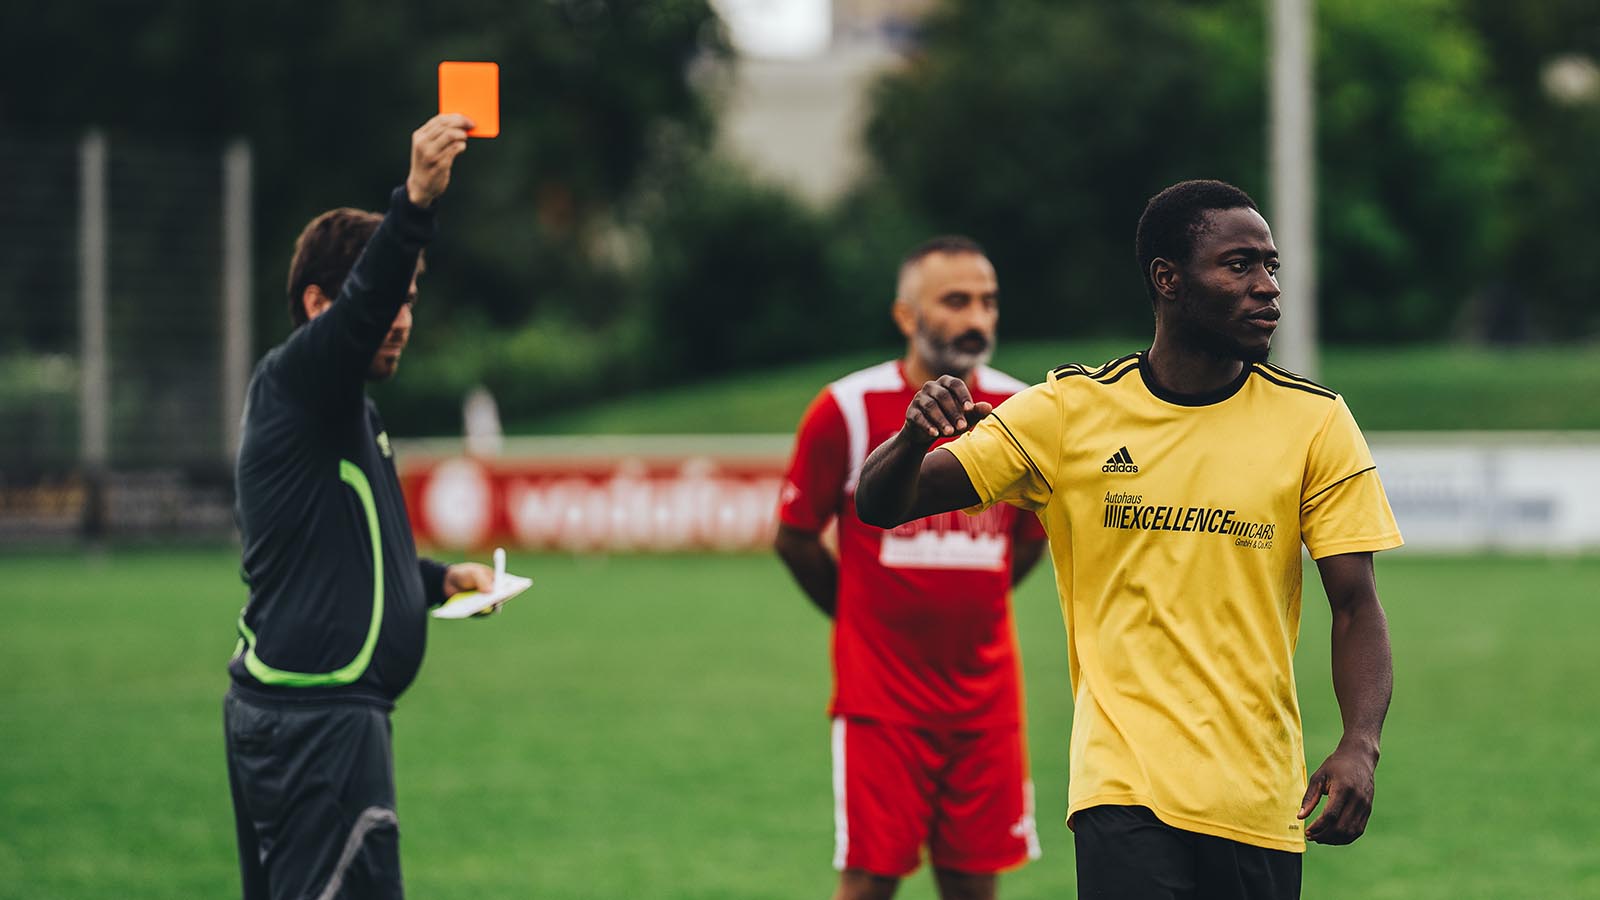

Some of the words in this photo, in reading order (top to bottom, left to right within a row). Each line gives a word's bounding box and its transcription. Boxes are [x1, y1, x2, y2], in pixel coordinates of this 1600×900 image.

[1102, 462, 1139, 473] adidas
[1104, 491, 1142, 504] Autohaus
[1248, 523, 1275, 540] CARS
[1235, 538, 1252, 548] GmbH
